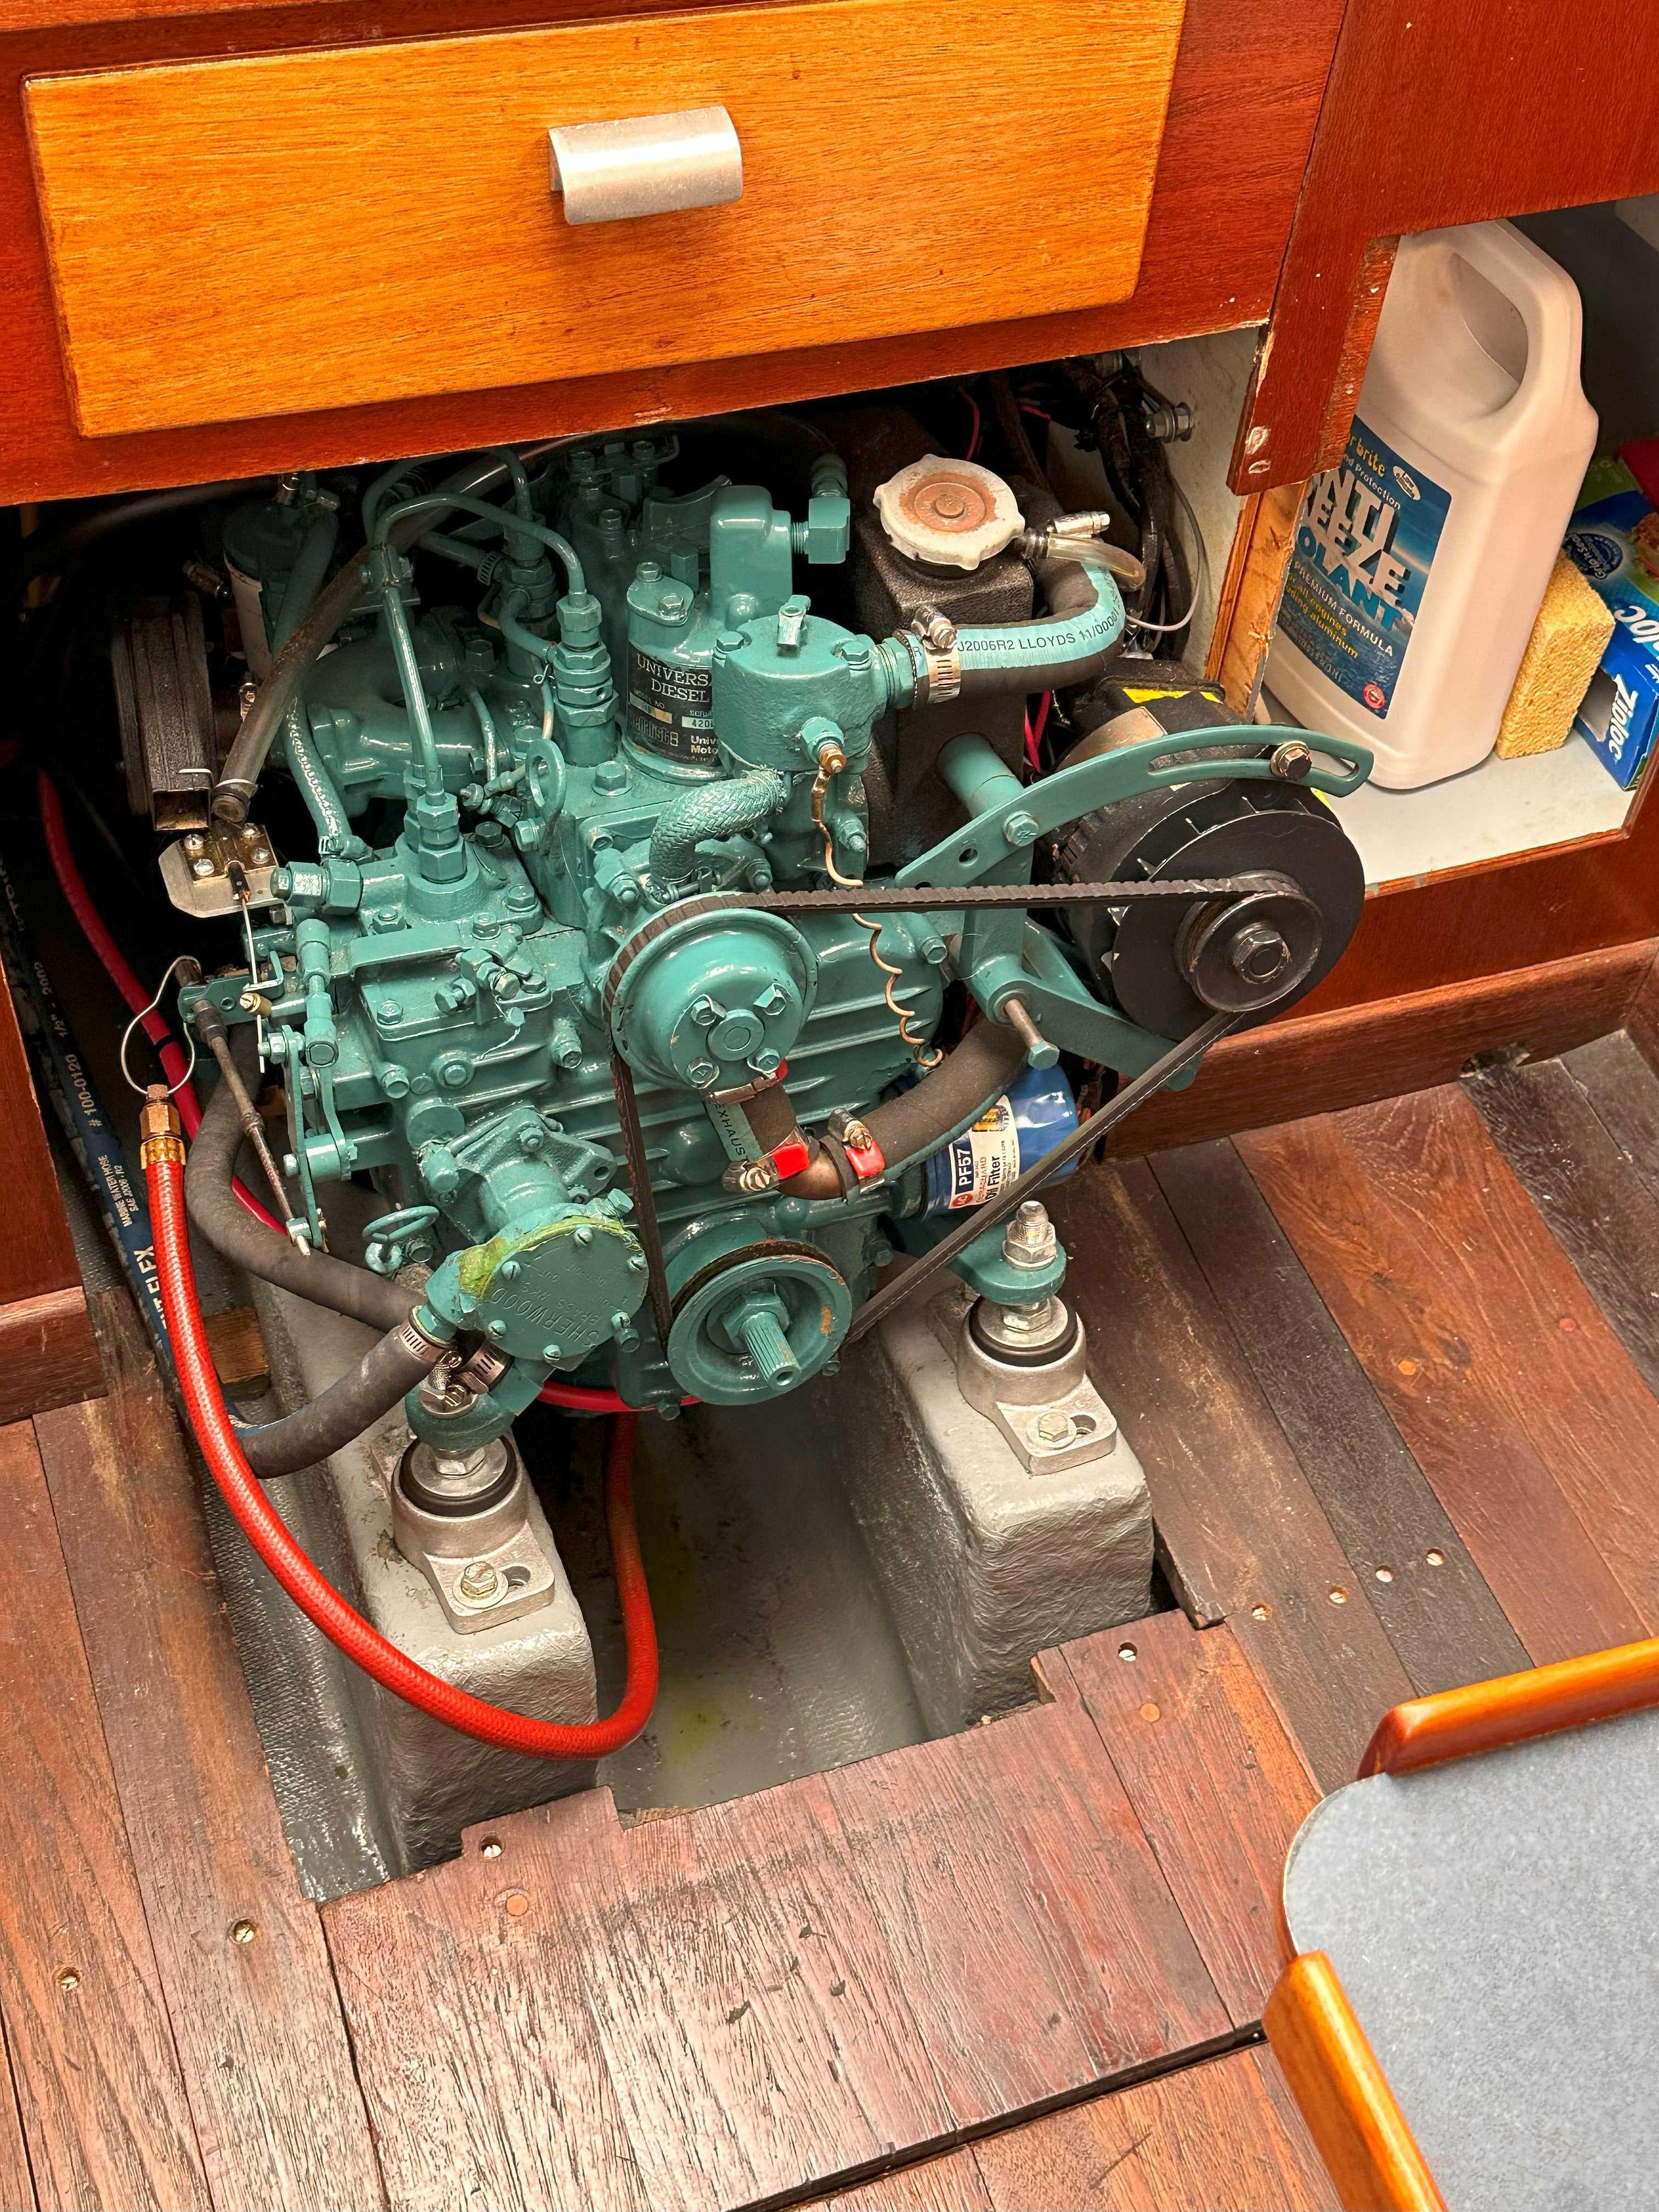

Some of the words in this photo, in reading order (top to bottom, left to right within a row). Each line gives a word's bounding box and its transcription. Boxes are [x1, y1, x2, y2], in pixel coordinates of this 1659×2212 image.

[1317, 469, 1396, 549] NTI
[1355, 464, 1401, 510] Protection
[1309, 488, 1408, 610] EEZE
[1294, 561, 1337, 611] PREMIUM
[1339, 606, 1393, 657] FORMULA
[1019, 633, 1076, 650] LLOYDS
[1310, 611, 1359, 659] aluminum
[636, 653, 712, 687] UNIVERS
[651, 678, 710, 703] DIESEL
[690, 735, 719, 744] Univ
[1609, 673, 1639, 760] Ziploc
[65, 1053, 97, 1116] 100-0120
[98, 1154, 114, 1176] HOSE
[956, 1148, 972, 1186] PF57
[988, 1156, 1001, 1186] Filter
[488, 1287, 600, 1348] SHERWOOD
